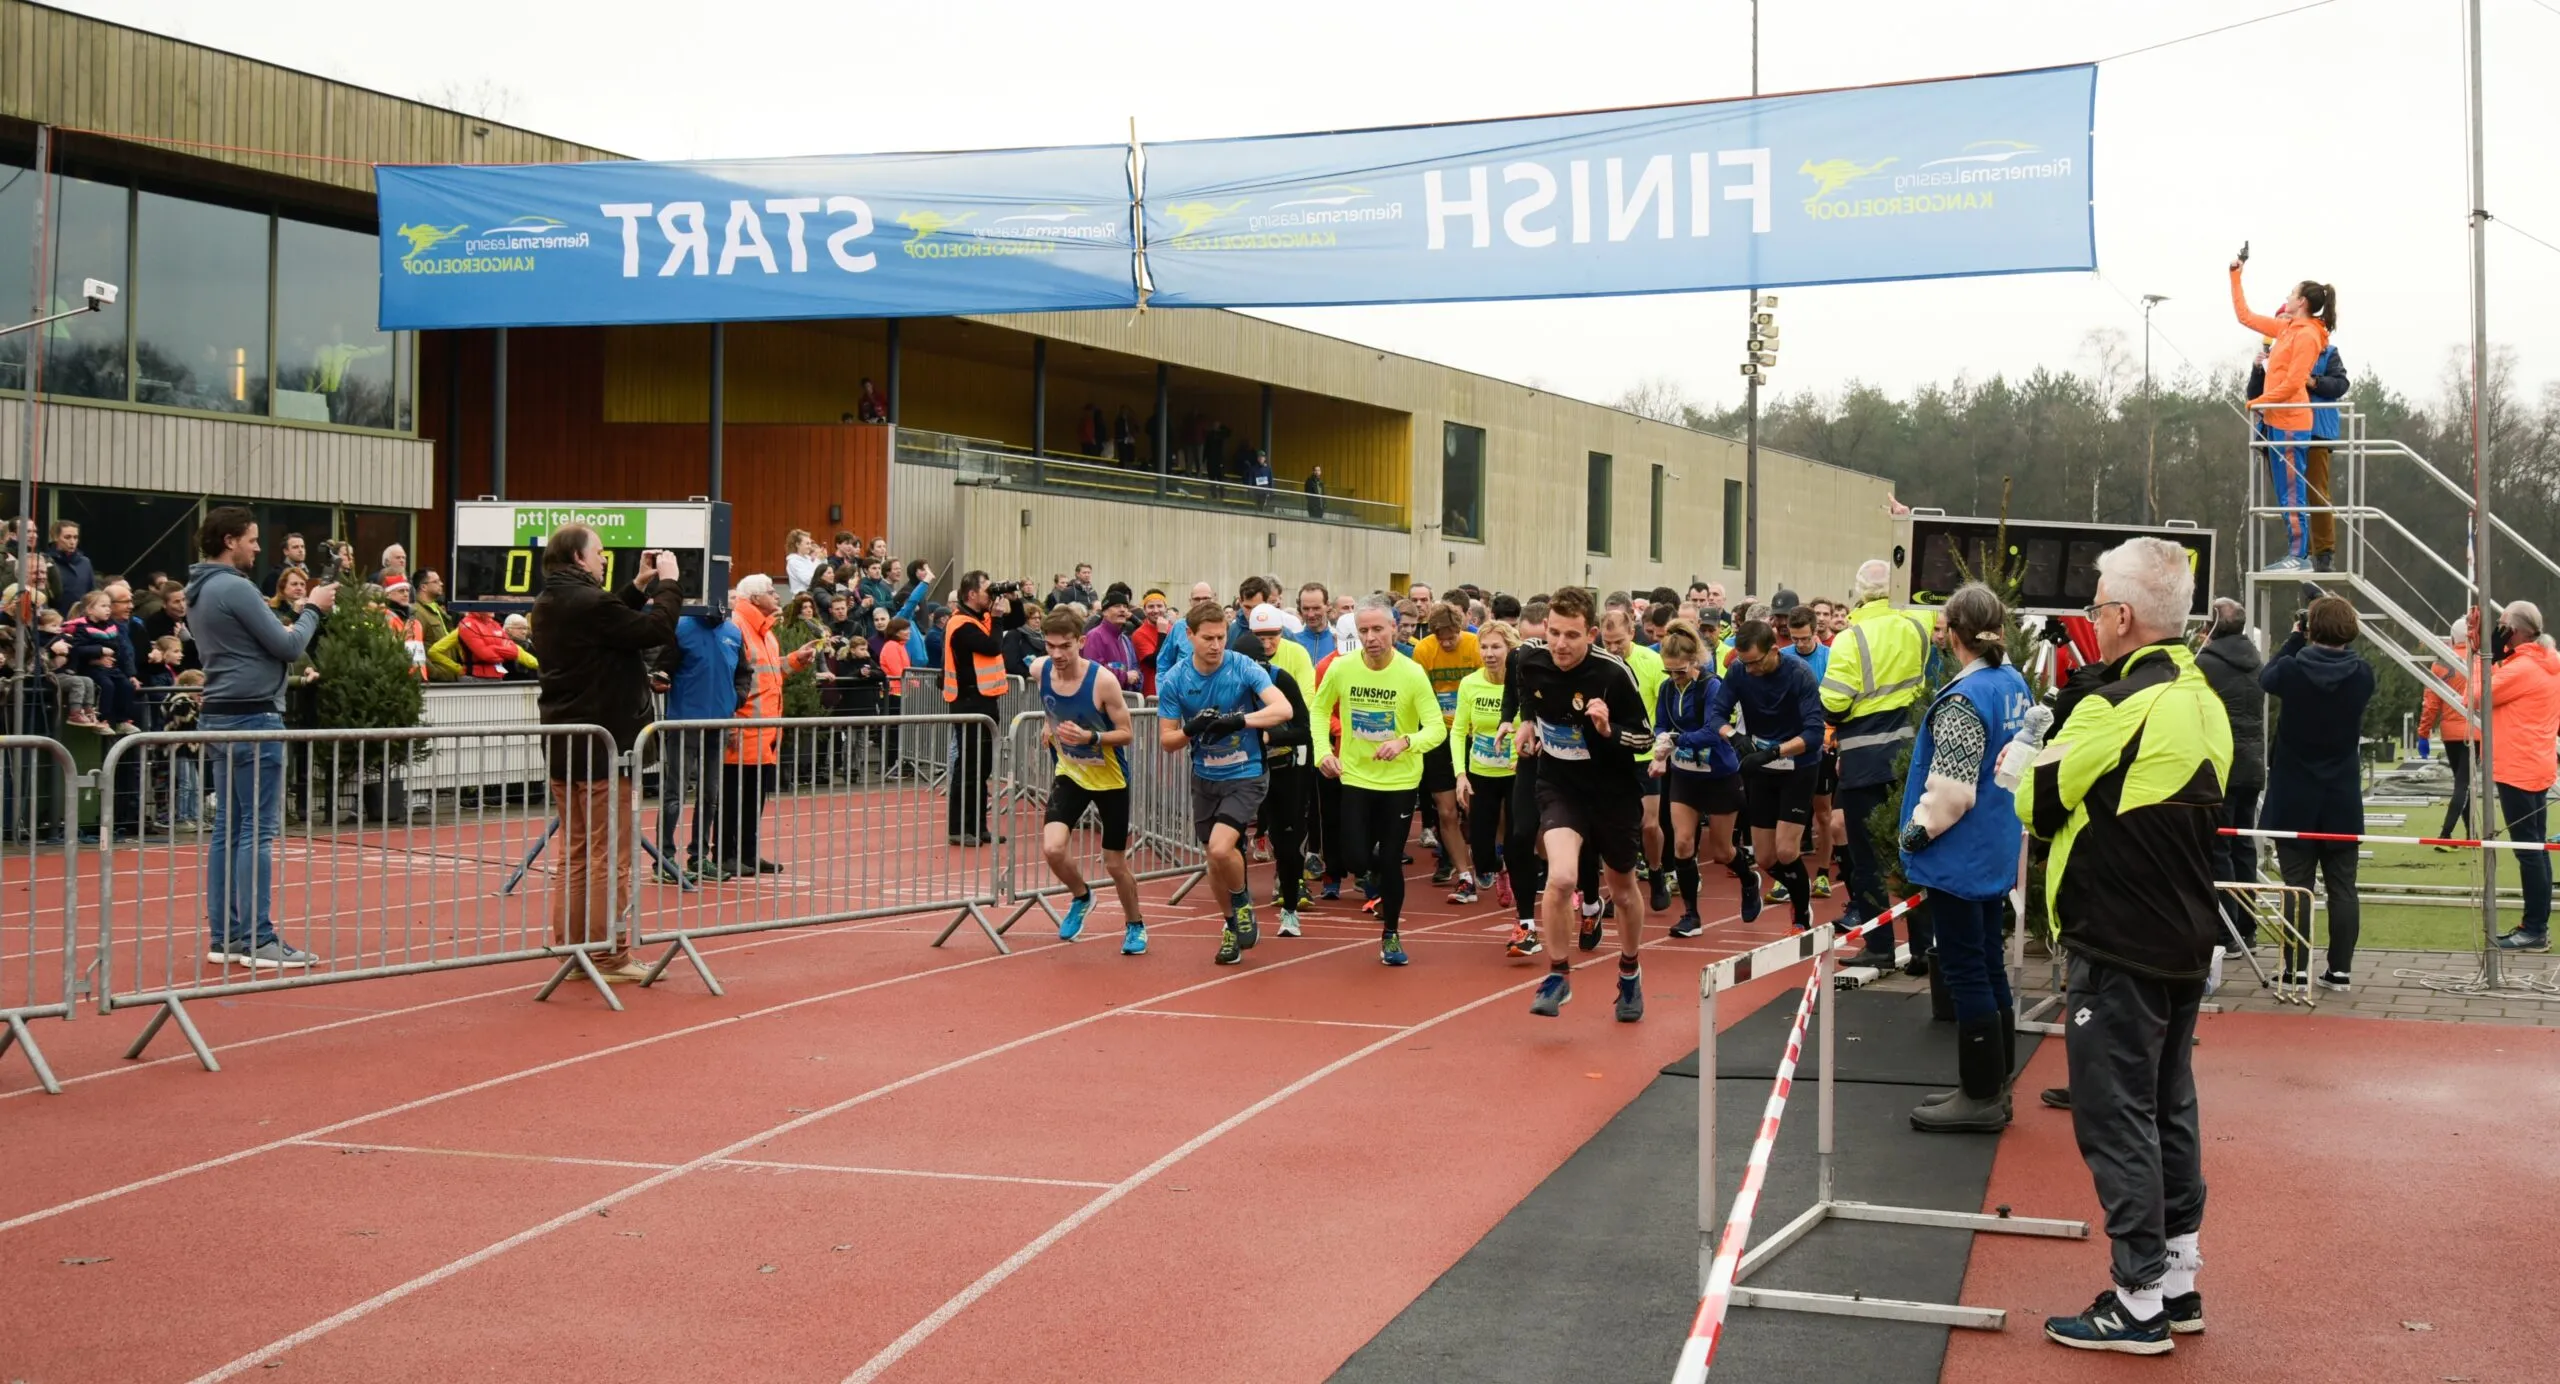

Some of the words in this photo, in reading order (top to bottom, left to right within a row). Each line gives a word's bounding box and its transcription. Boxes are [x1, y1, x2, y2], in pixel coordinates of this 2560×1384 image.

[516, 511, 544, 529] ptt
[551, 510, 625, 527] telecom
[505, 550, 532, 593] 0
[1350, 686, 1397, 701] RUNSHOP
[1475, 697, 1501, 708] RUNS
